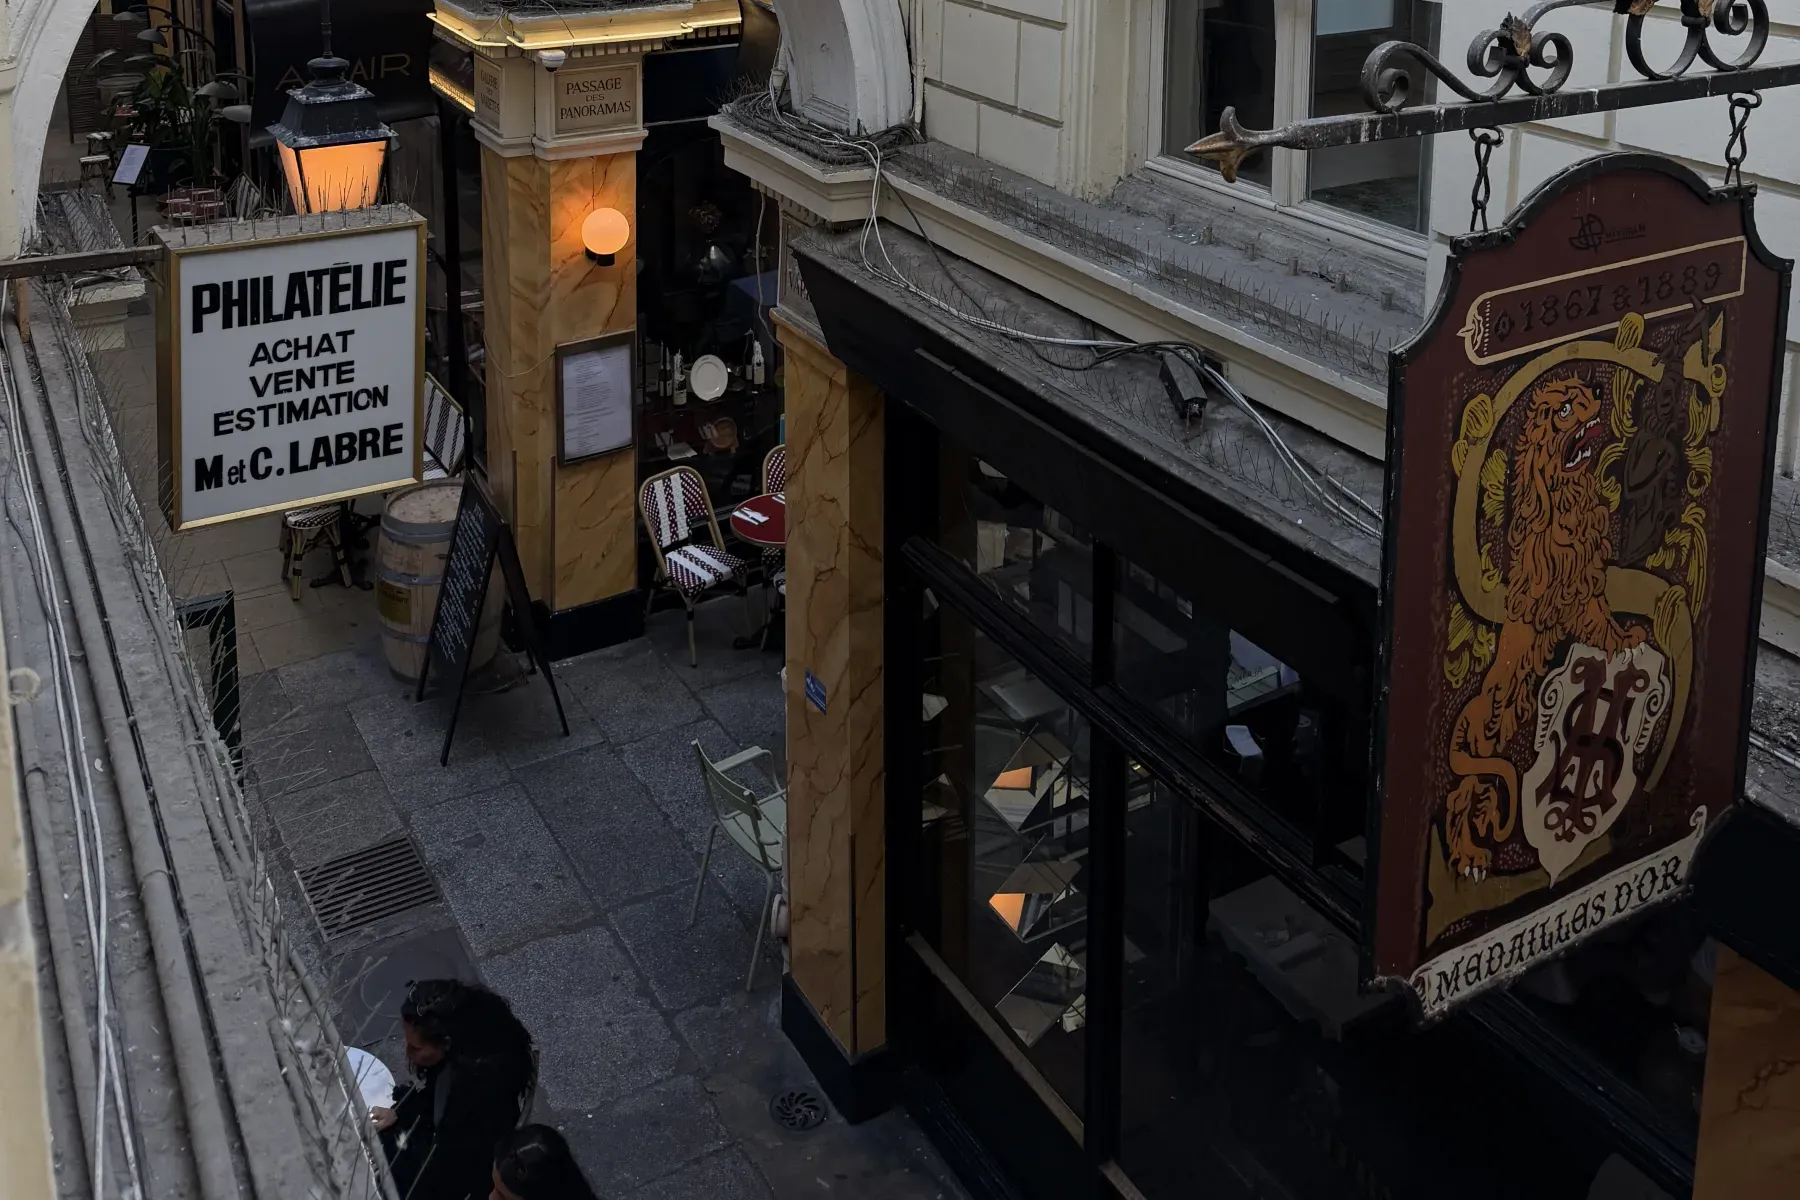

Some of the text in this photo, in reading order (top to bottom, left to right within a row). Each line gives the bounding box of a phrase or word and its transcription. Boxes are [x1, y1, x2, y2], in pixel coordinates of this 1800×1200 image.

[274, 52, 412, 91] AAIR
[566, 77, 622, 95] PASSAGE
[560, 101, 631, 120] PANORAMAS
[585, 93, 605, 102] DES
[192, 259, 407, 334] PHILATÉLIE
[1520, 284, 1604, 333] 1867
[1636, 261, 1723, 306] 1889
[249, 329, 355, 367] ACHAT
[249, 360, 355, 398] VENTE
[213, 385, 389, 436] ESTIMATION
